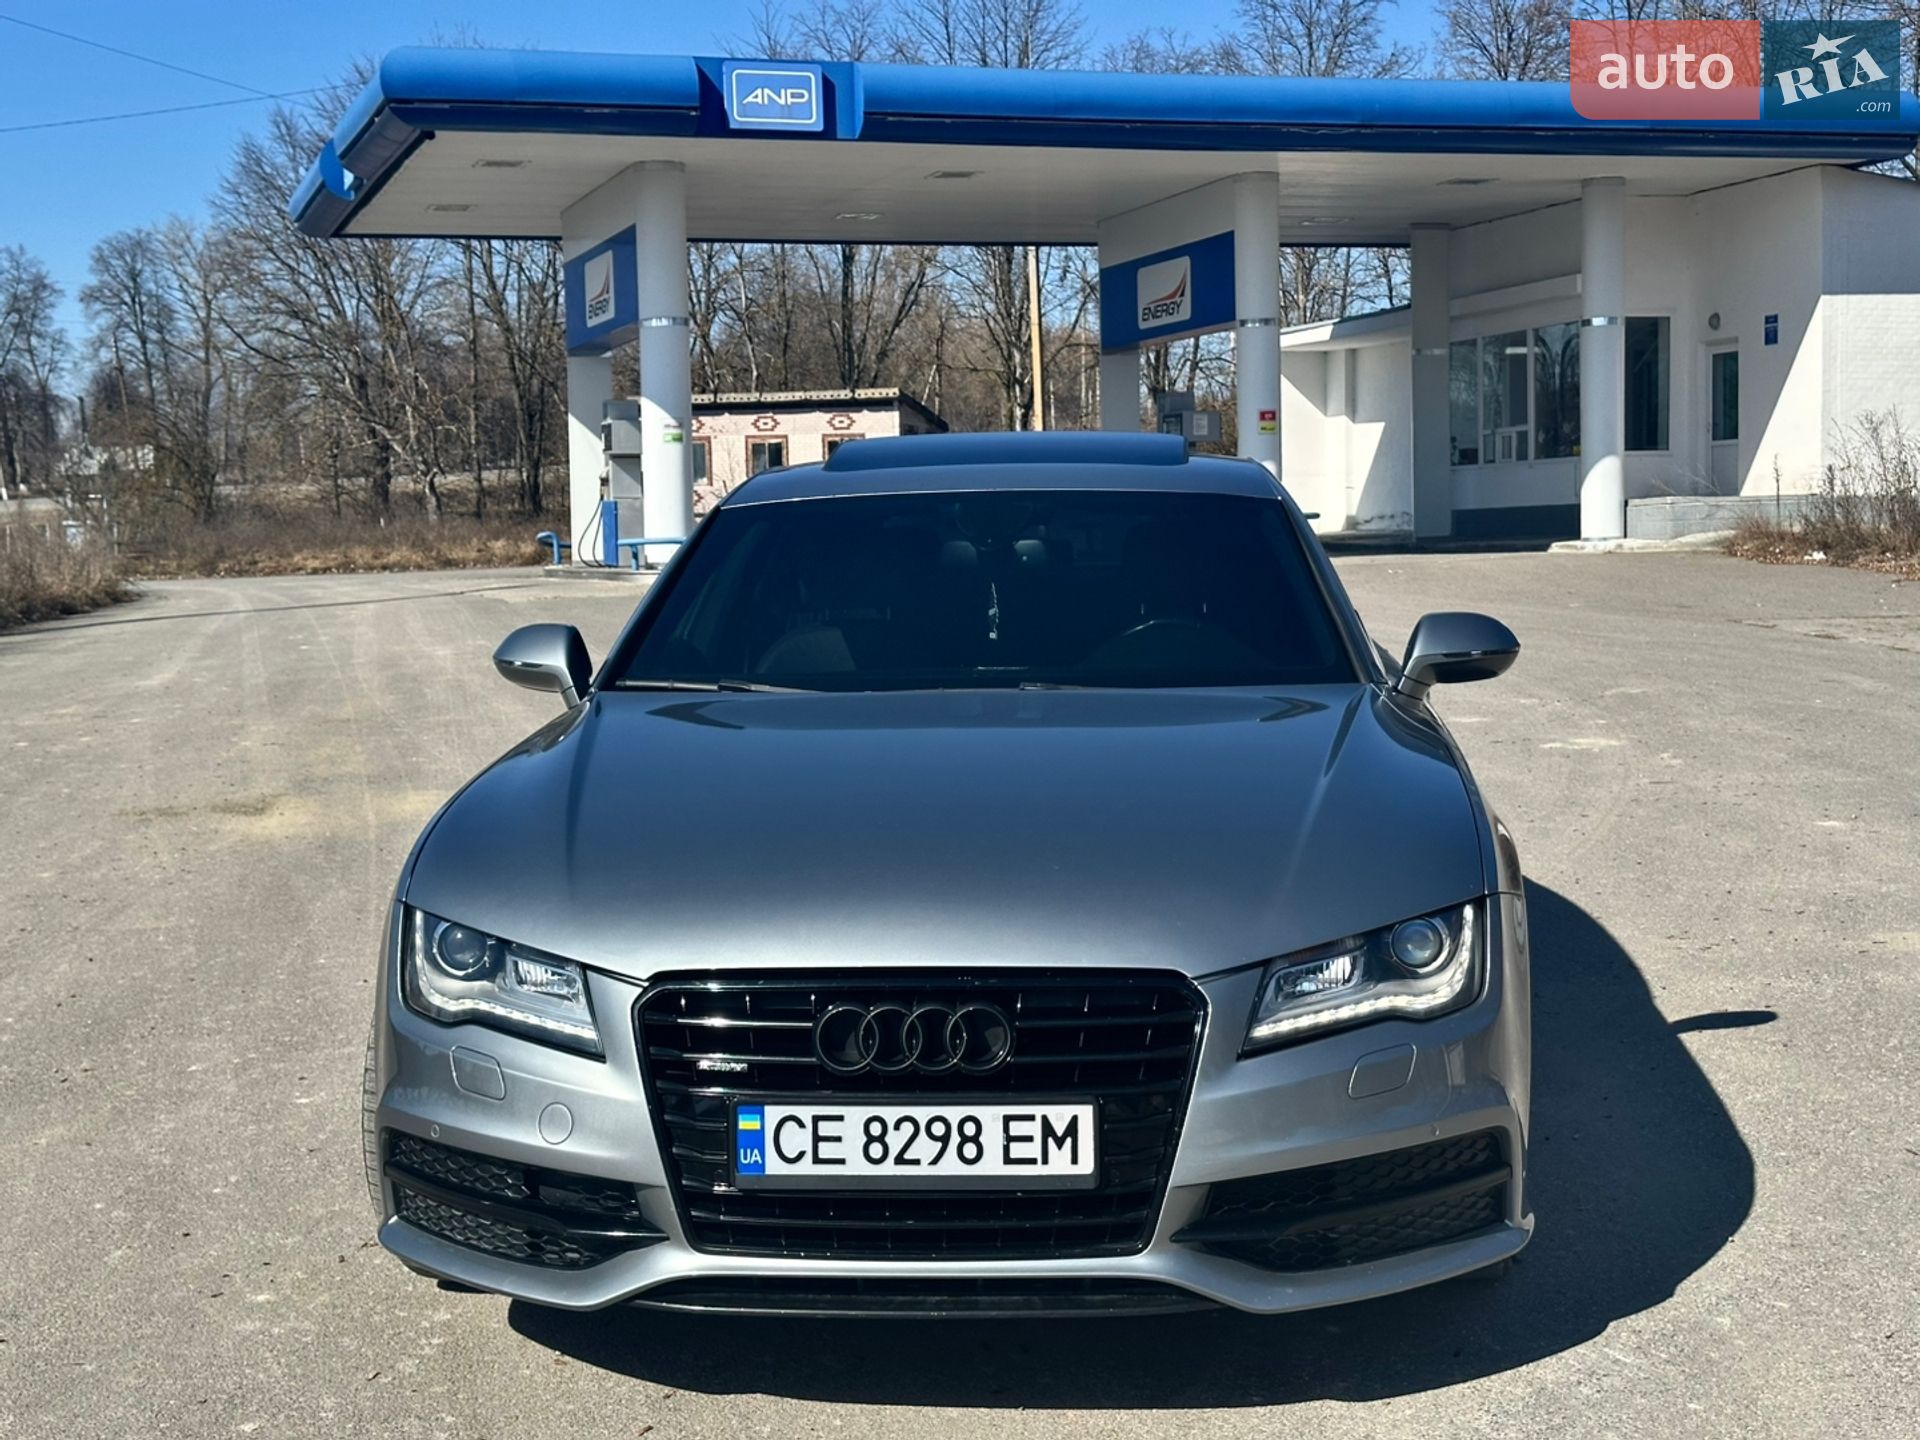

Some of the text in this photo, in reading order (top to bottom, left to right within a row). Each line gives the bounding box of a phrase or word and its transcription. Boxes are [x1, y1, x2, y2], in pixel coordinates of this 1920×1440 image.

[742, 87, 809, 106] ANP
[1142, 300, 1183, 321] ENERGY
[773, 1114, 1078, 1165] CE 8298 EM
[740, 1147, 763, 1164] UA
